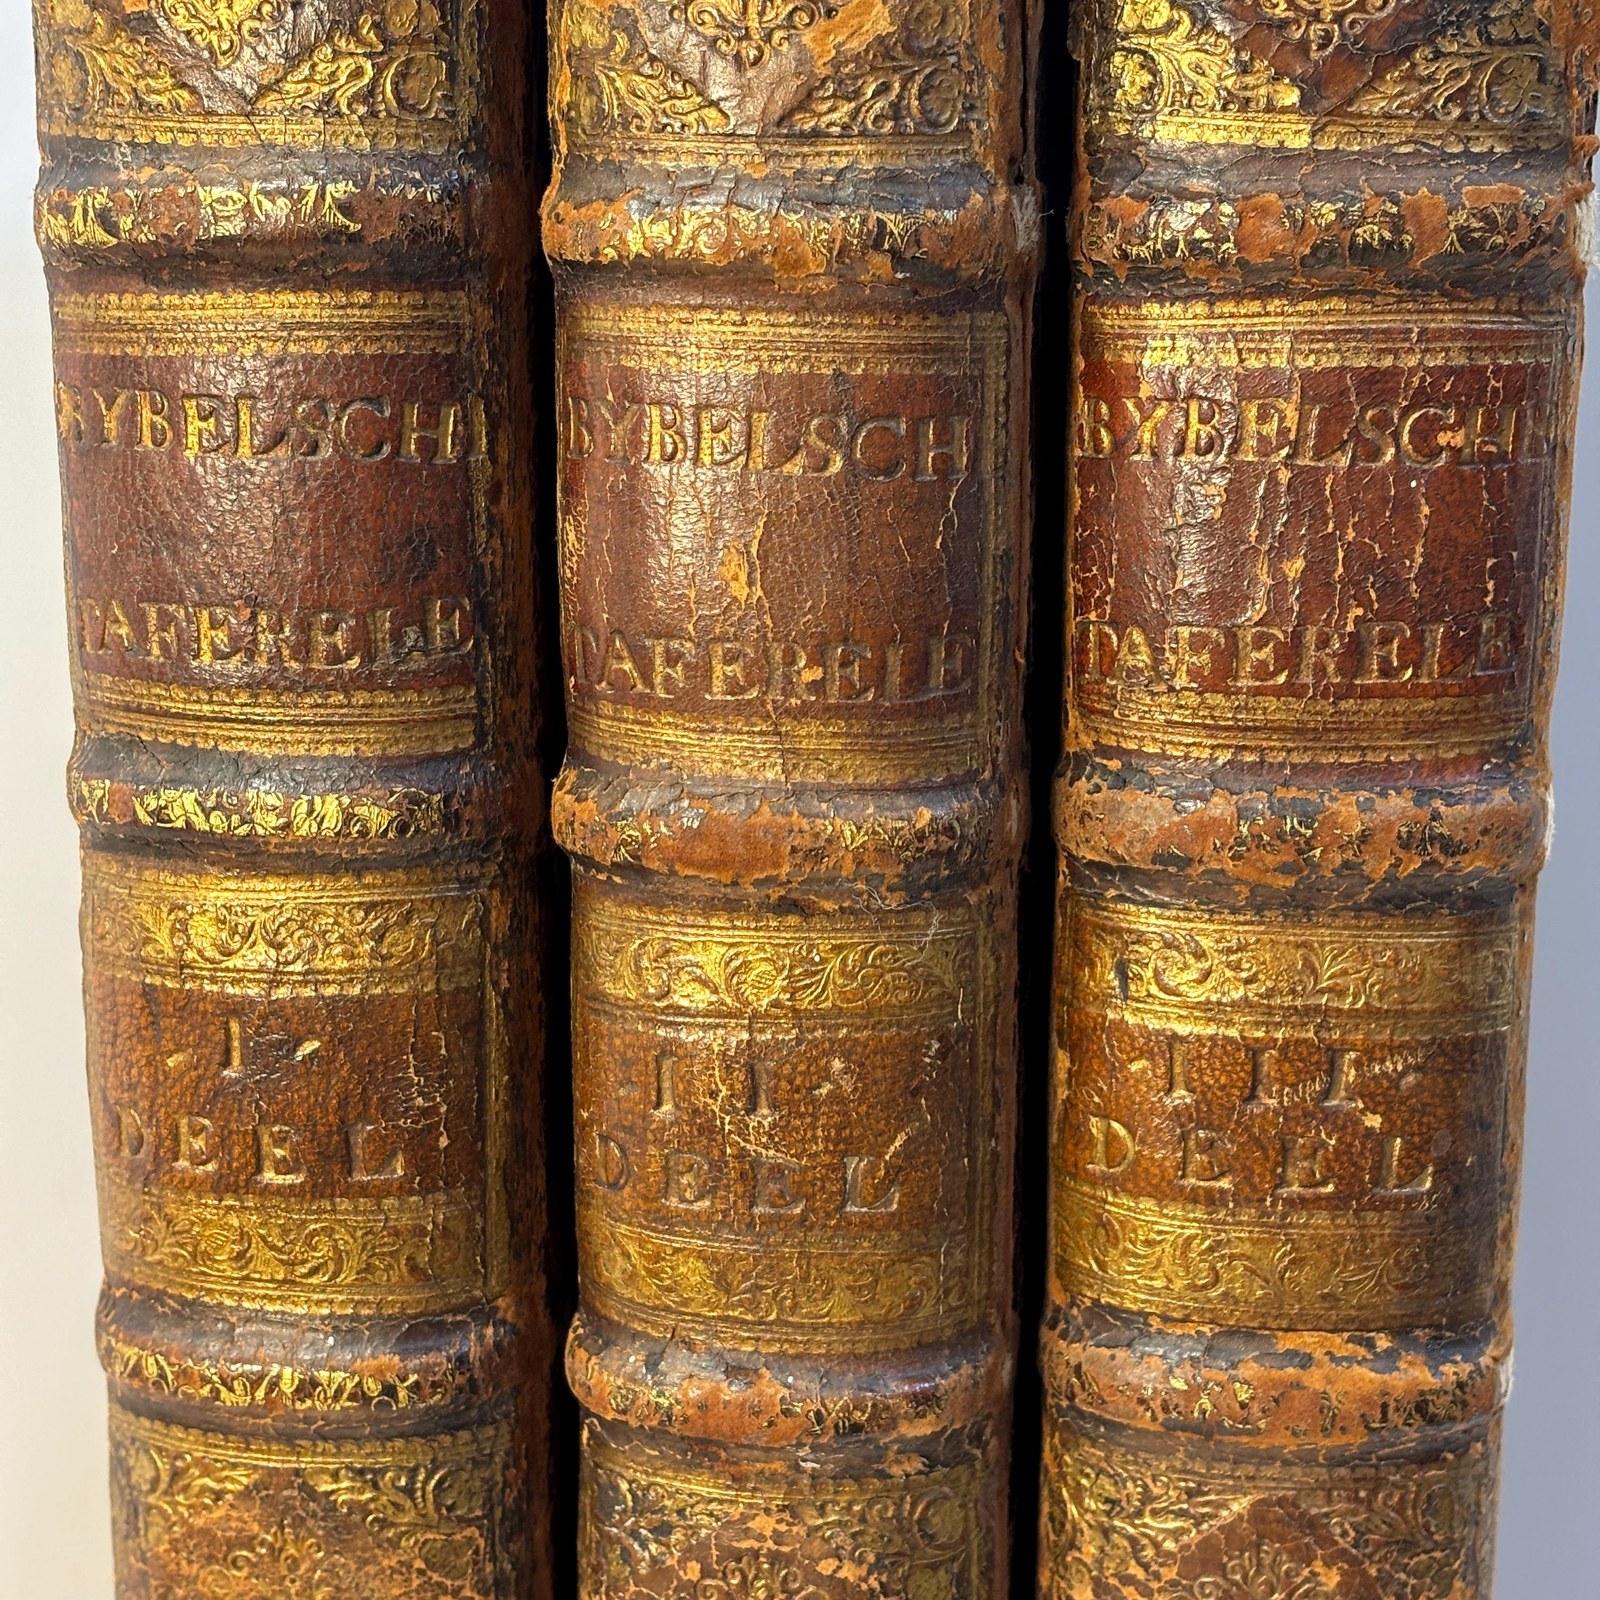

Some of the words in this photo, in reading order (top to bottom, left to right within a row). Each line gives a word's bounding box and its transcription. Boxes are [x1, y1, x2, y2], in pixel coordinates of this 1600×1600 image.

[115, 1104, 405, 1185] DEEL
[594, 1132, 900, 1215] DEEL
[1087, 1116, 1434, 1198] DEEL
